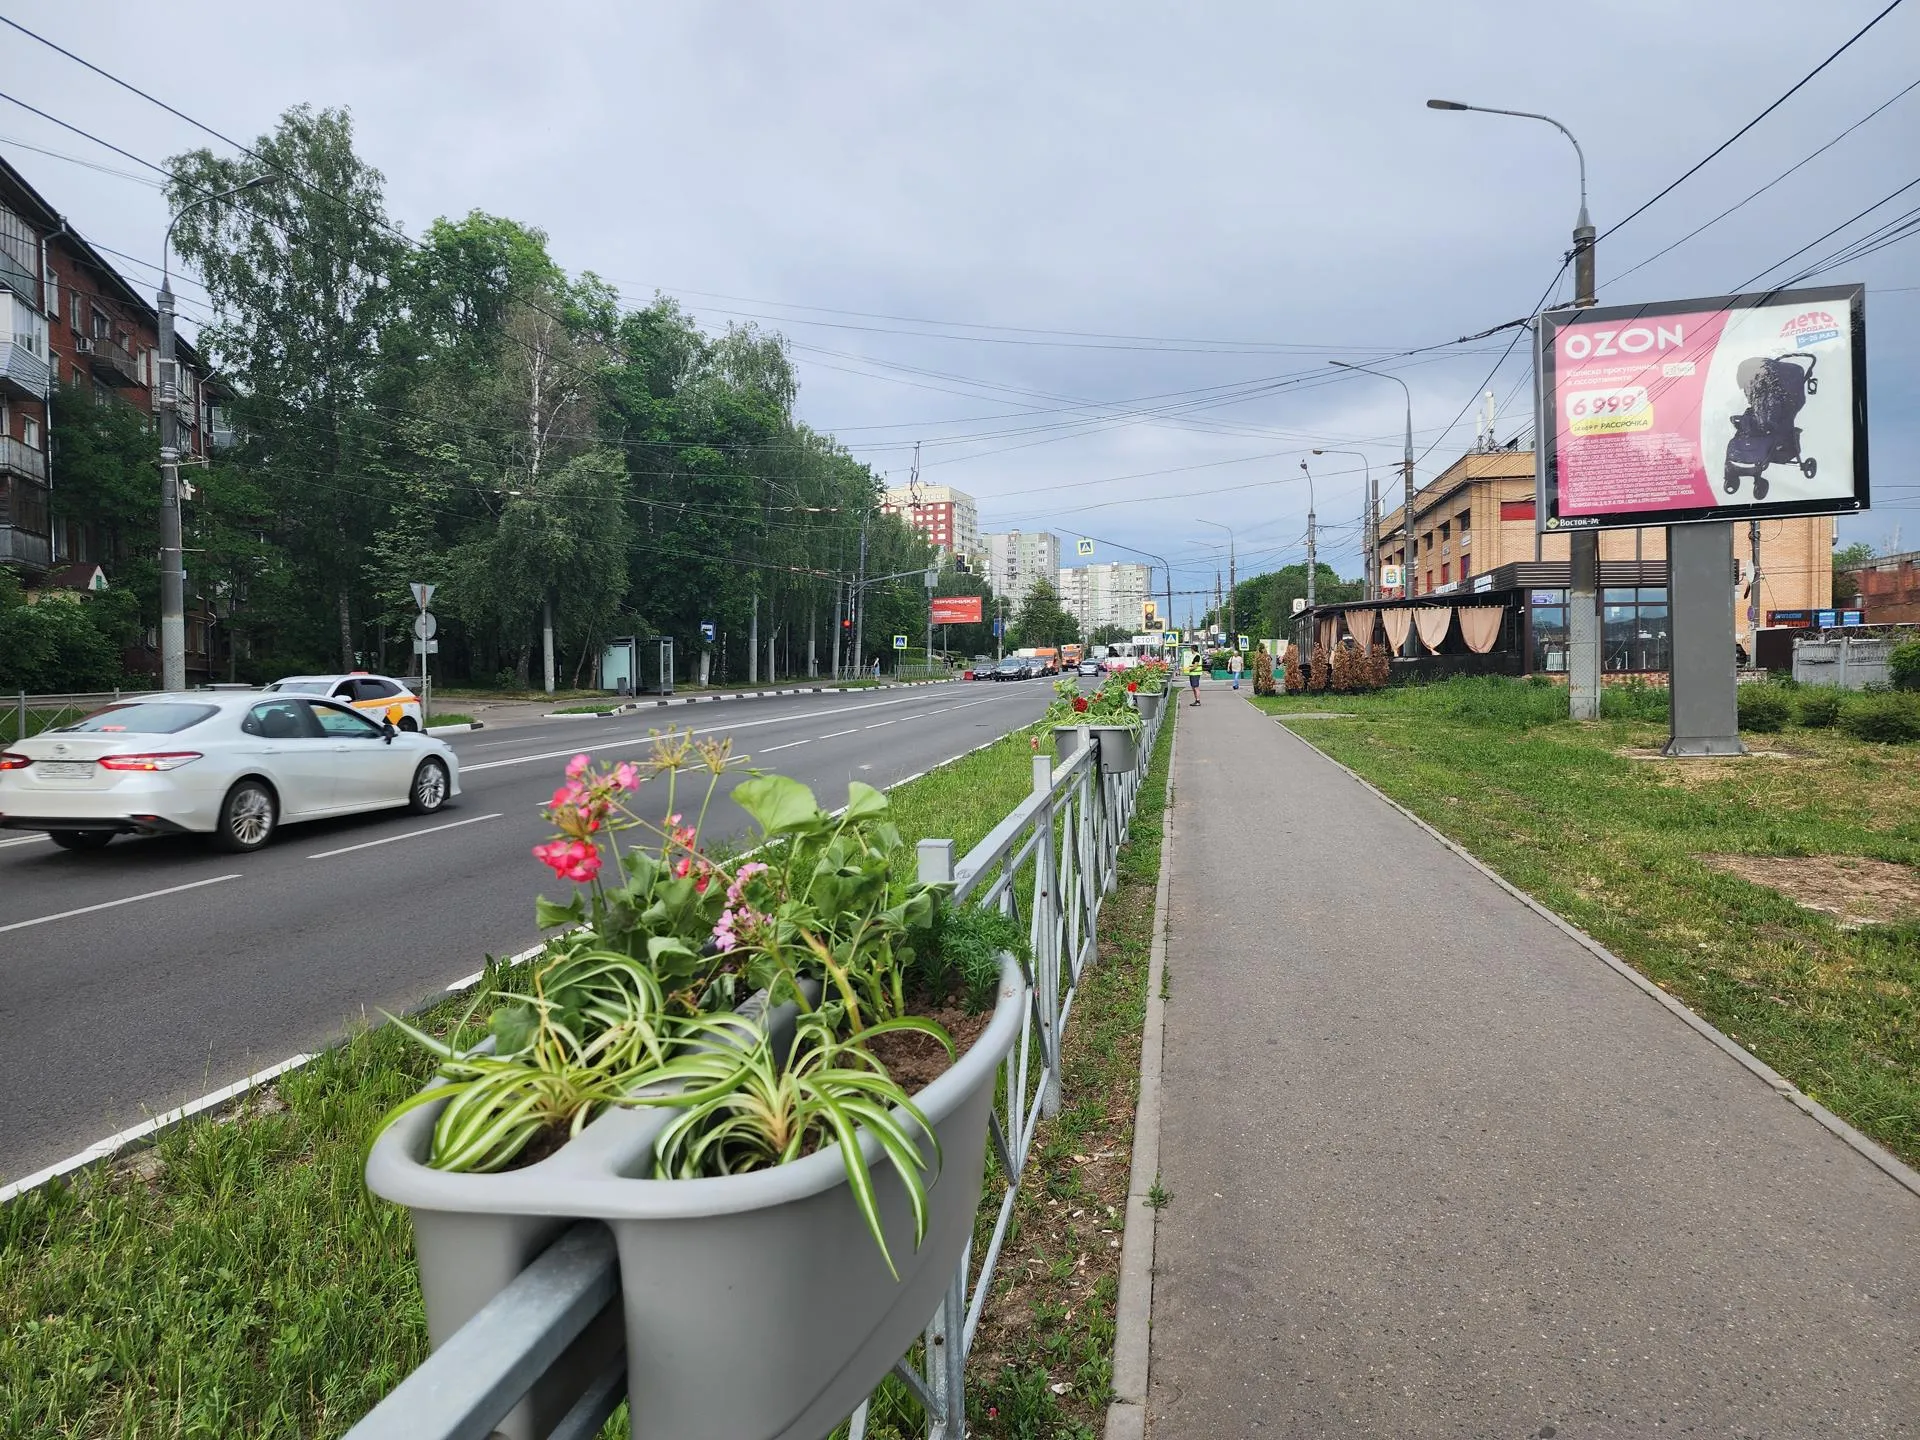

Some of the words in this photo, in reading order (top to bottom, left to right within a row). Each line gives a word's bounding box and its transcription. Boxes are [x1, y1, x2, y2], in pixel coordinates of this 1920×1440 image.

[1565, 324, 1683, 359] OZON
[1592, 394, 1635, 414] 999
[1600, 419, 1648, 429] РАССРОЧКА
